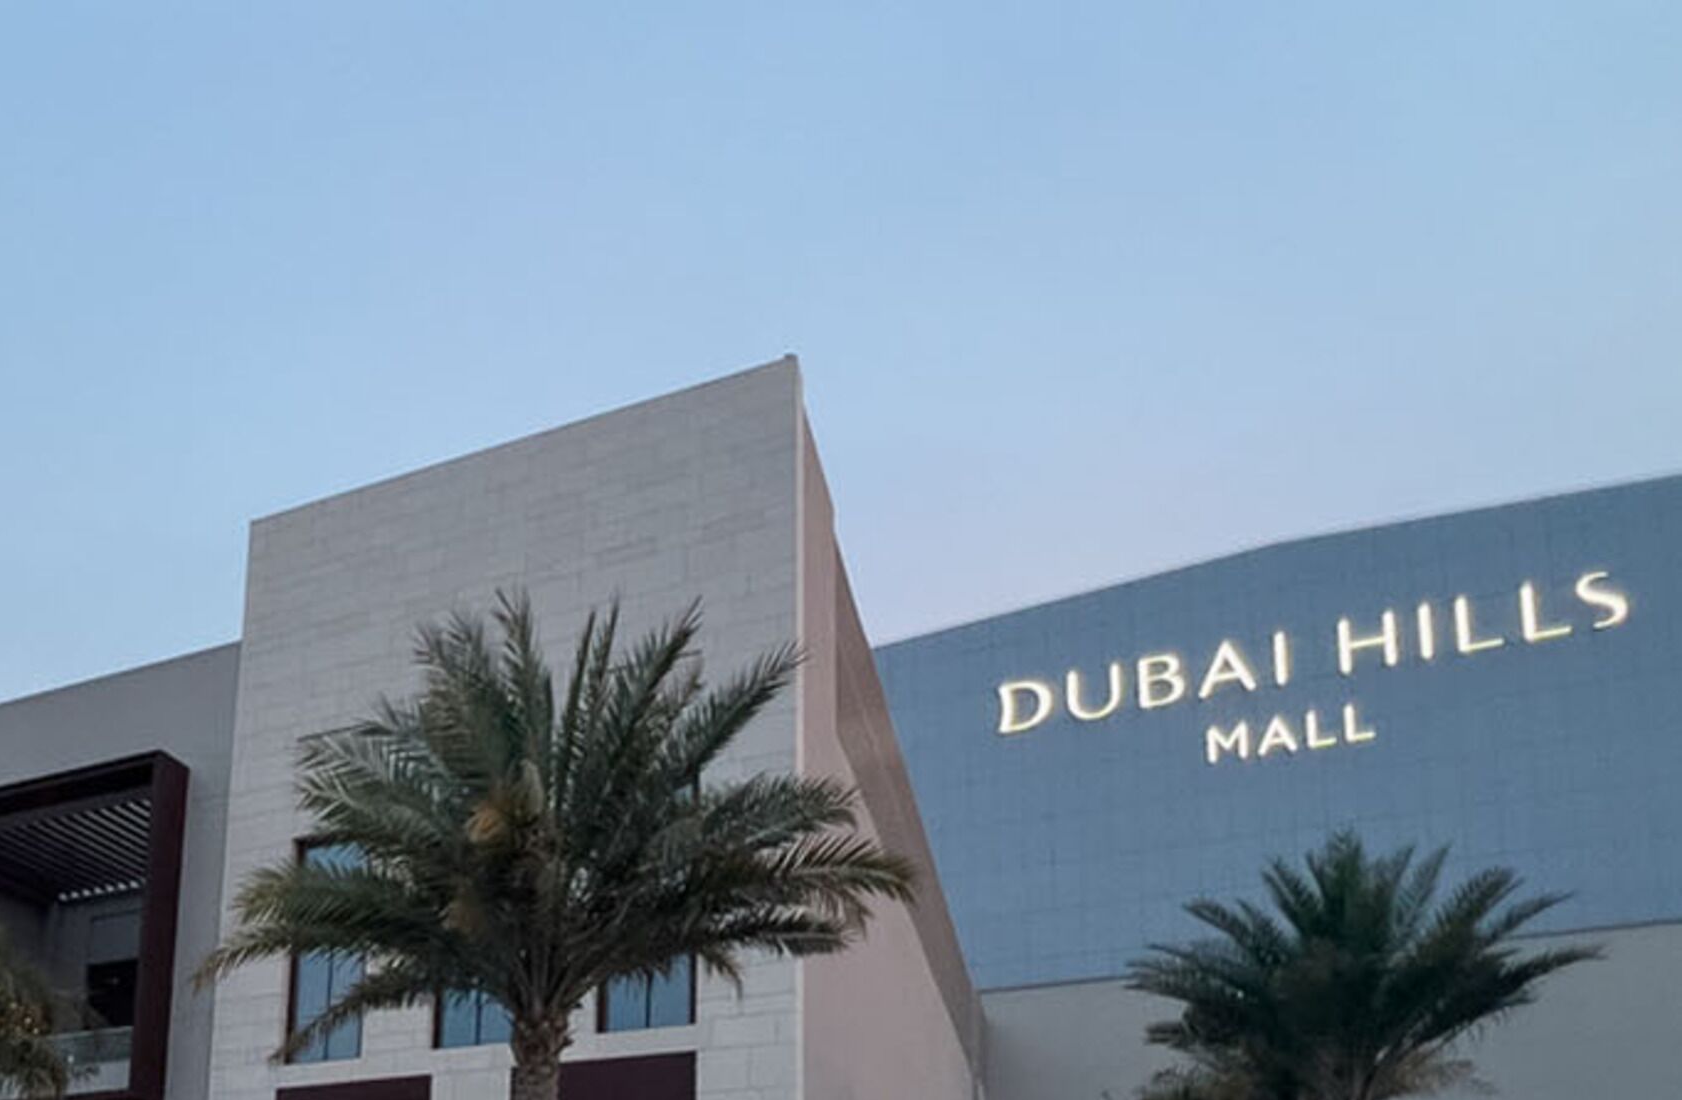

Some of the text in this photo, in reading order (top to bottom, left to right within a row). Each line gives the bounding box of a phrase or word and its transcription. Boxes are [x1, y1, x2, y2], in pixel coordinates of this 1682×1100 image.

[998, 572, 1629, 733] DUBAI HILLS
[1206, 704, 1375, 763] MALL
